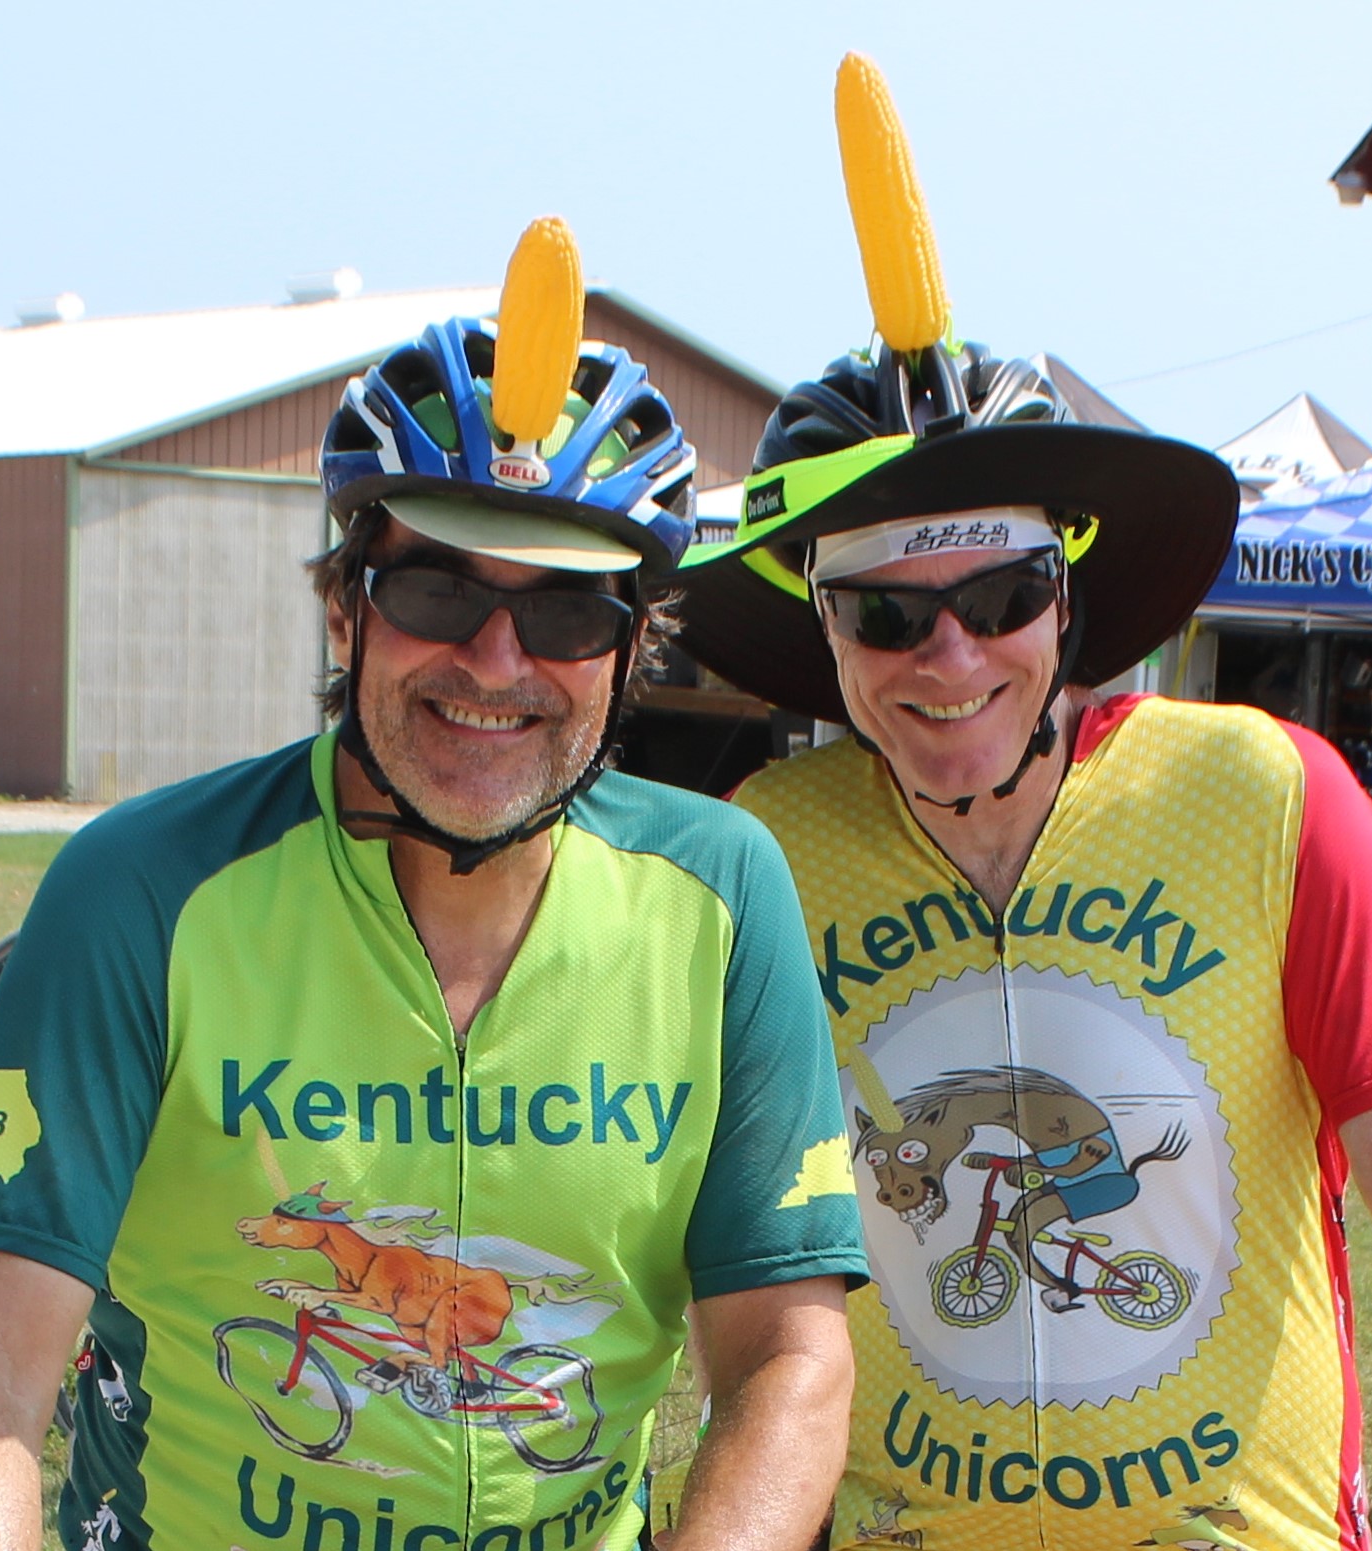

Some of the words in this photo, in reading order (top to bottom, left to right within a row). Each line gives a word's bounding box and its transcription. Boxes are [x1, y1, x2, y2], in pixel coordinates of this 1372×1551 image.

[498, 464, 540, 483] BELL
[1237, 540, 1342, 586] Nick's
[823, 877, 1227, 1020] Kentucky
[222, 1057, 693, 1165] Kentucky
[882, 1390, 1242, 1513] Unicorns
